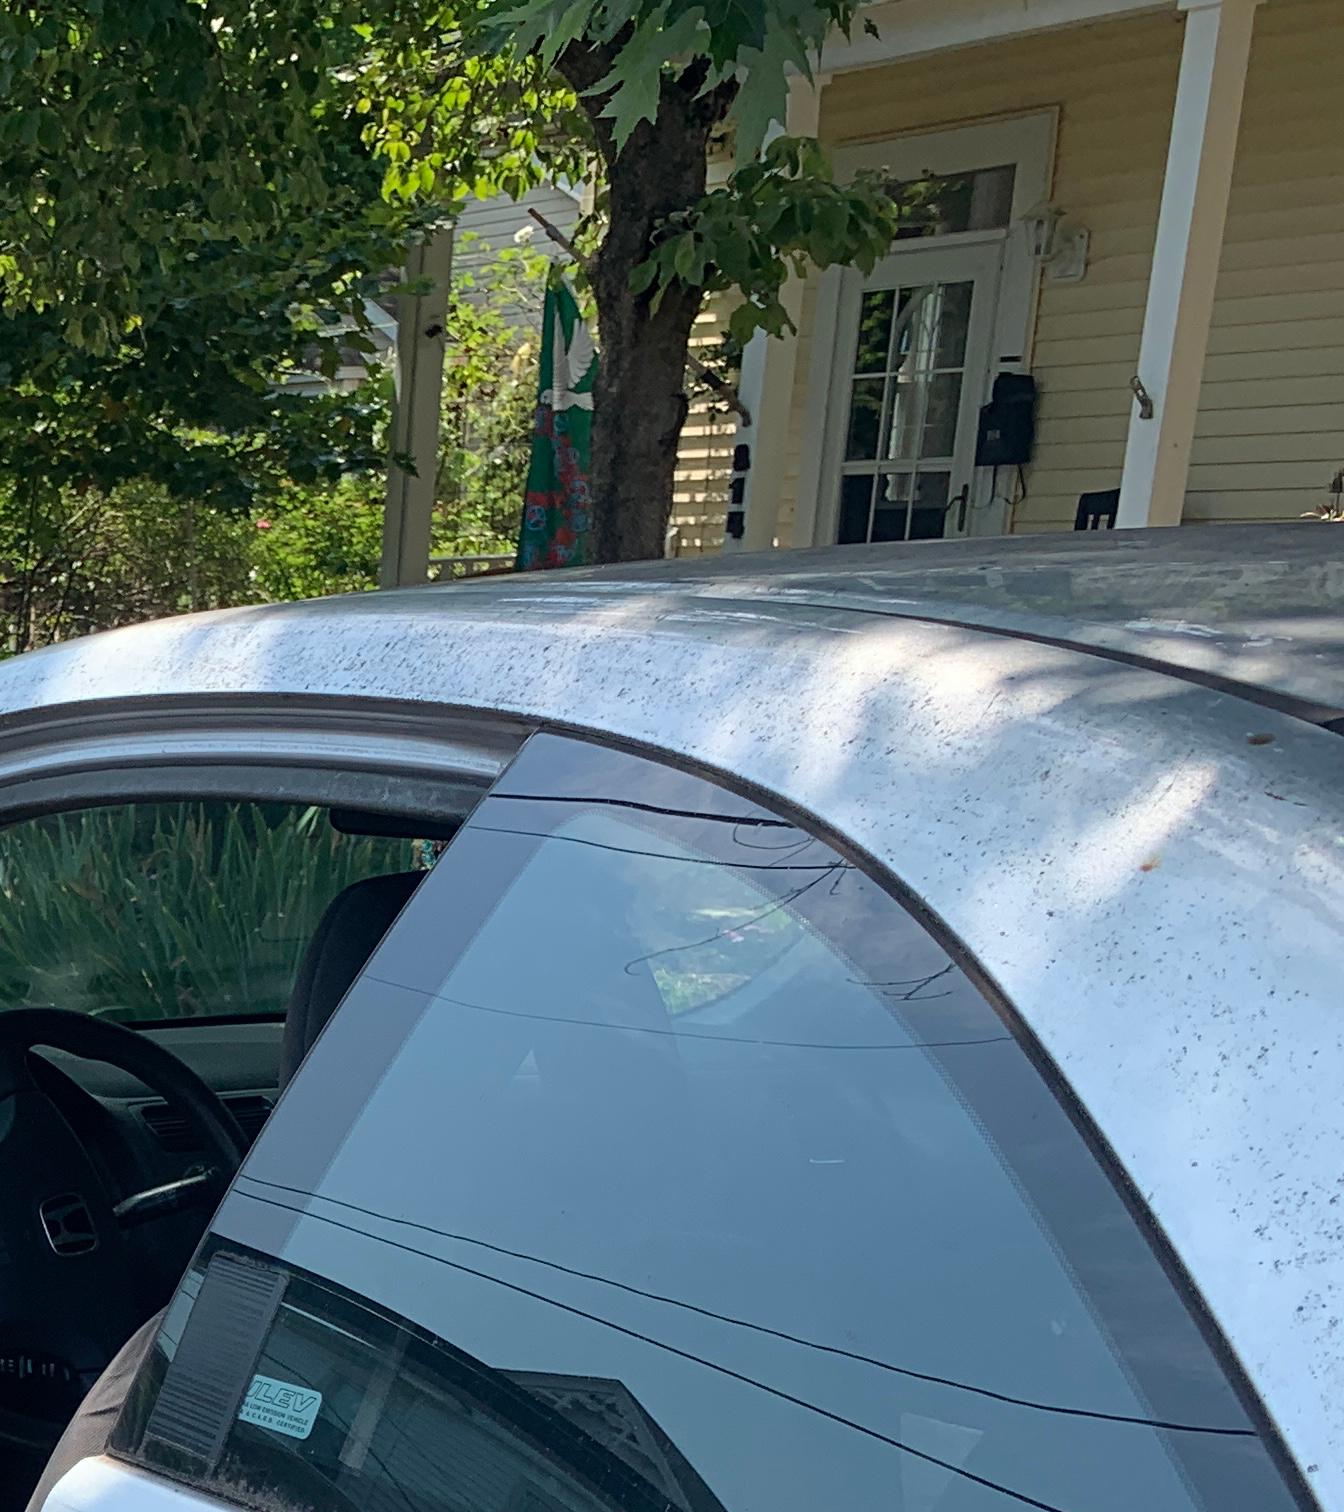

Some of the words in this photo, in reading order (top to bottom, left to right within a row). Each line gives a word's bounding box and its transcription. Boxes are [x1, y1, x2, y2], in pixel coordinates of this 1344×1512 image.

[250, 1402, 261, 1412] LOW
[261, 1407, 286, 1419] EMISSION
[287, 1414, 309, 1426] VEHICLE
